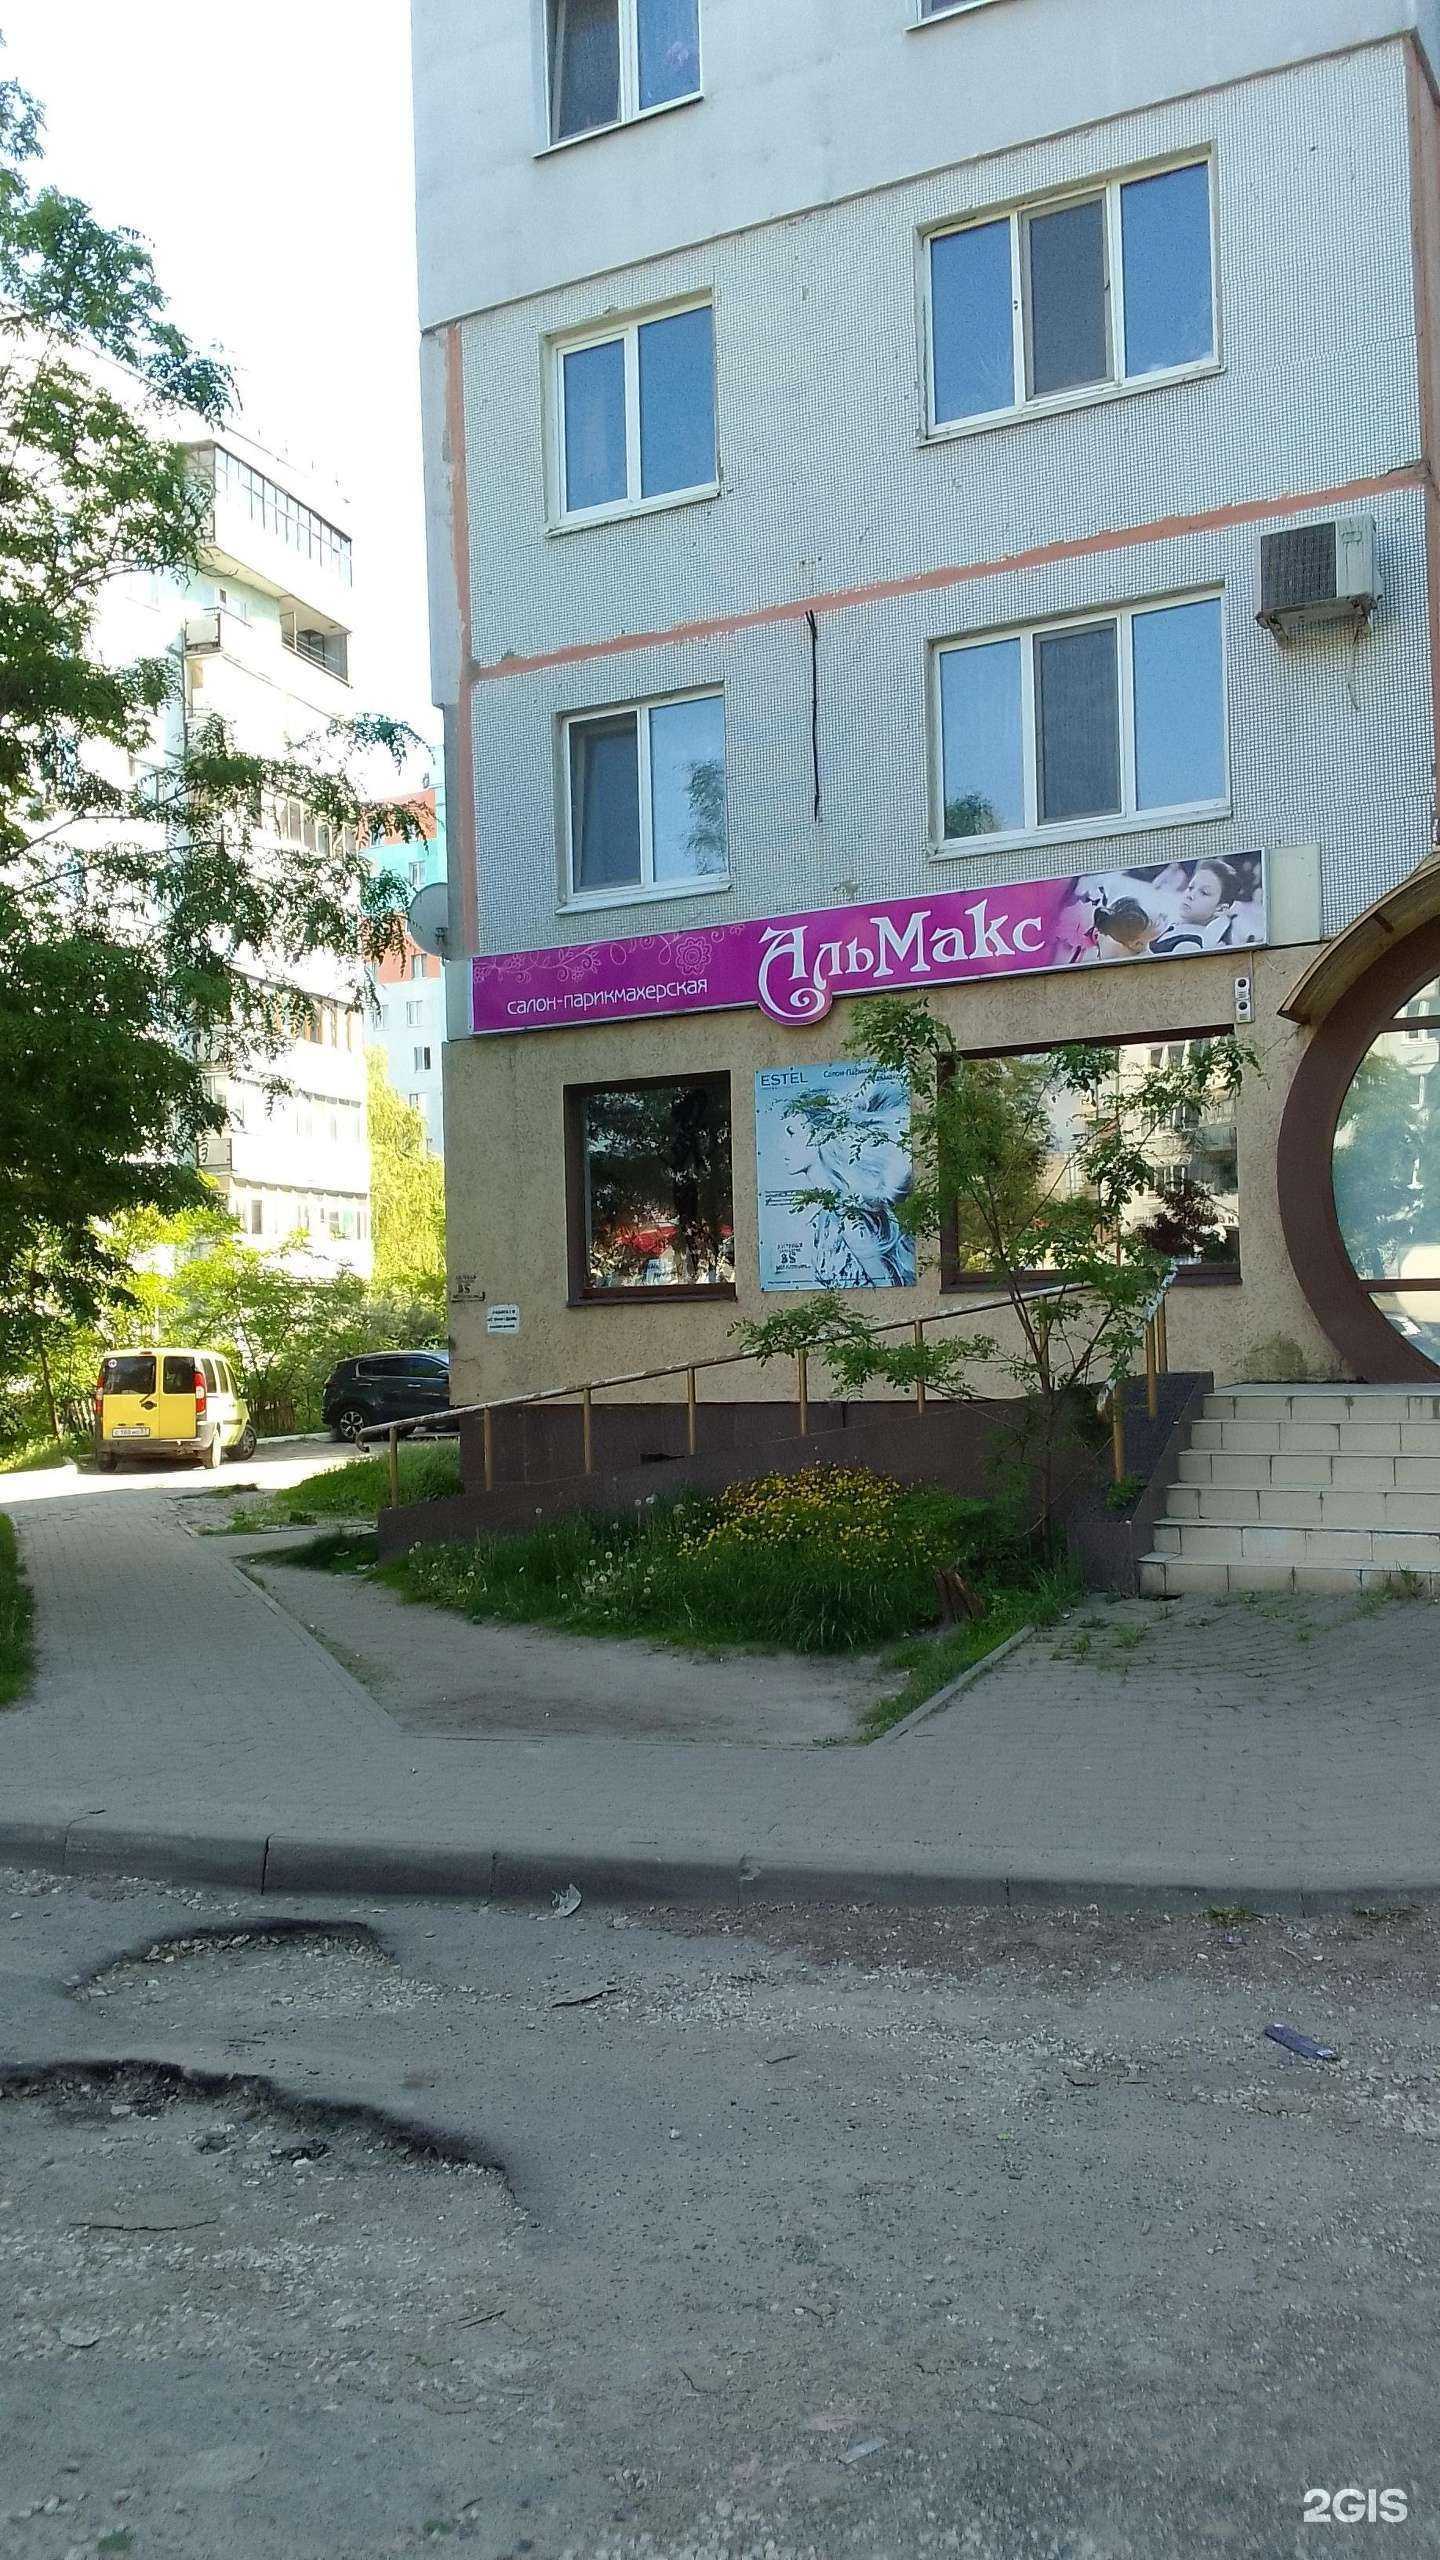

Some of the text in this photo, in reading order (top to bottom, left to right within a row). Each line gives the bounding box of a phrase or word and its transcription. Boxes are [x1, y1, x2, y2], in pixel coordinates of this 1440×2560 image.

[758, 899, 1046, 1018] АльМакс
[506, 978, 708, 1015] салон-парикмахерская
[761, 1072, 808, 1086] ESTEL
